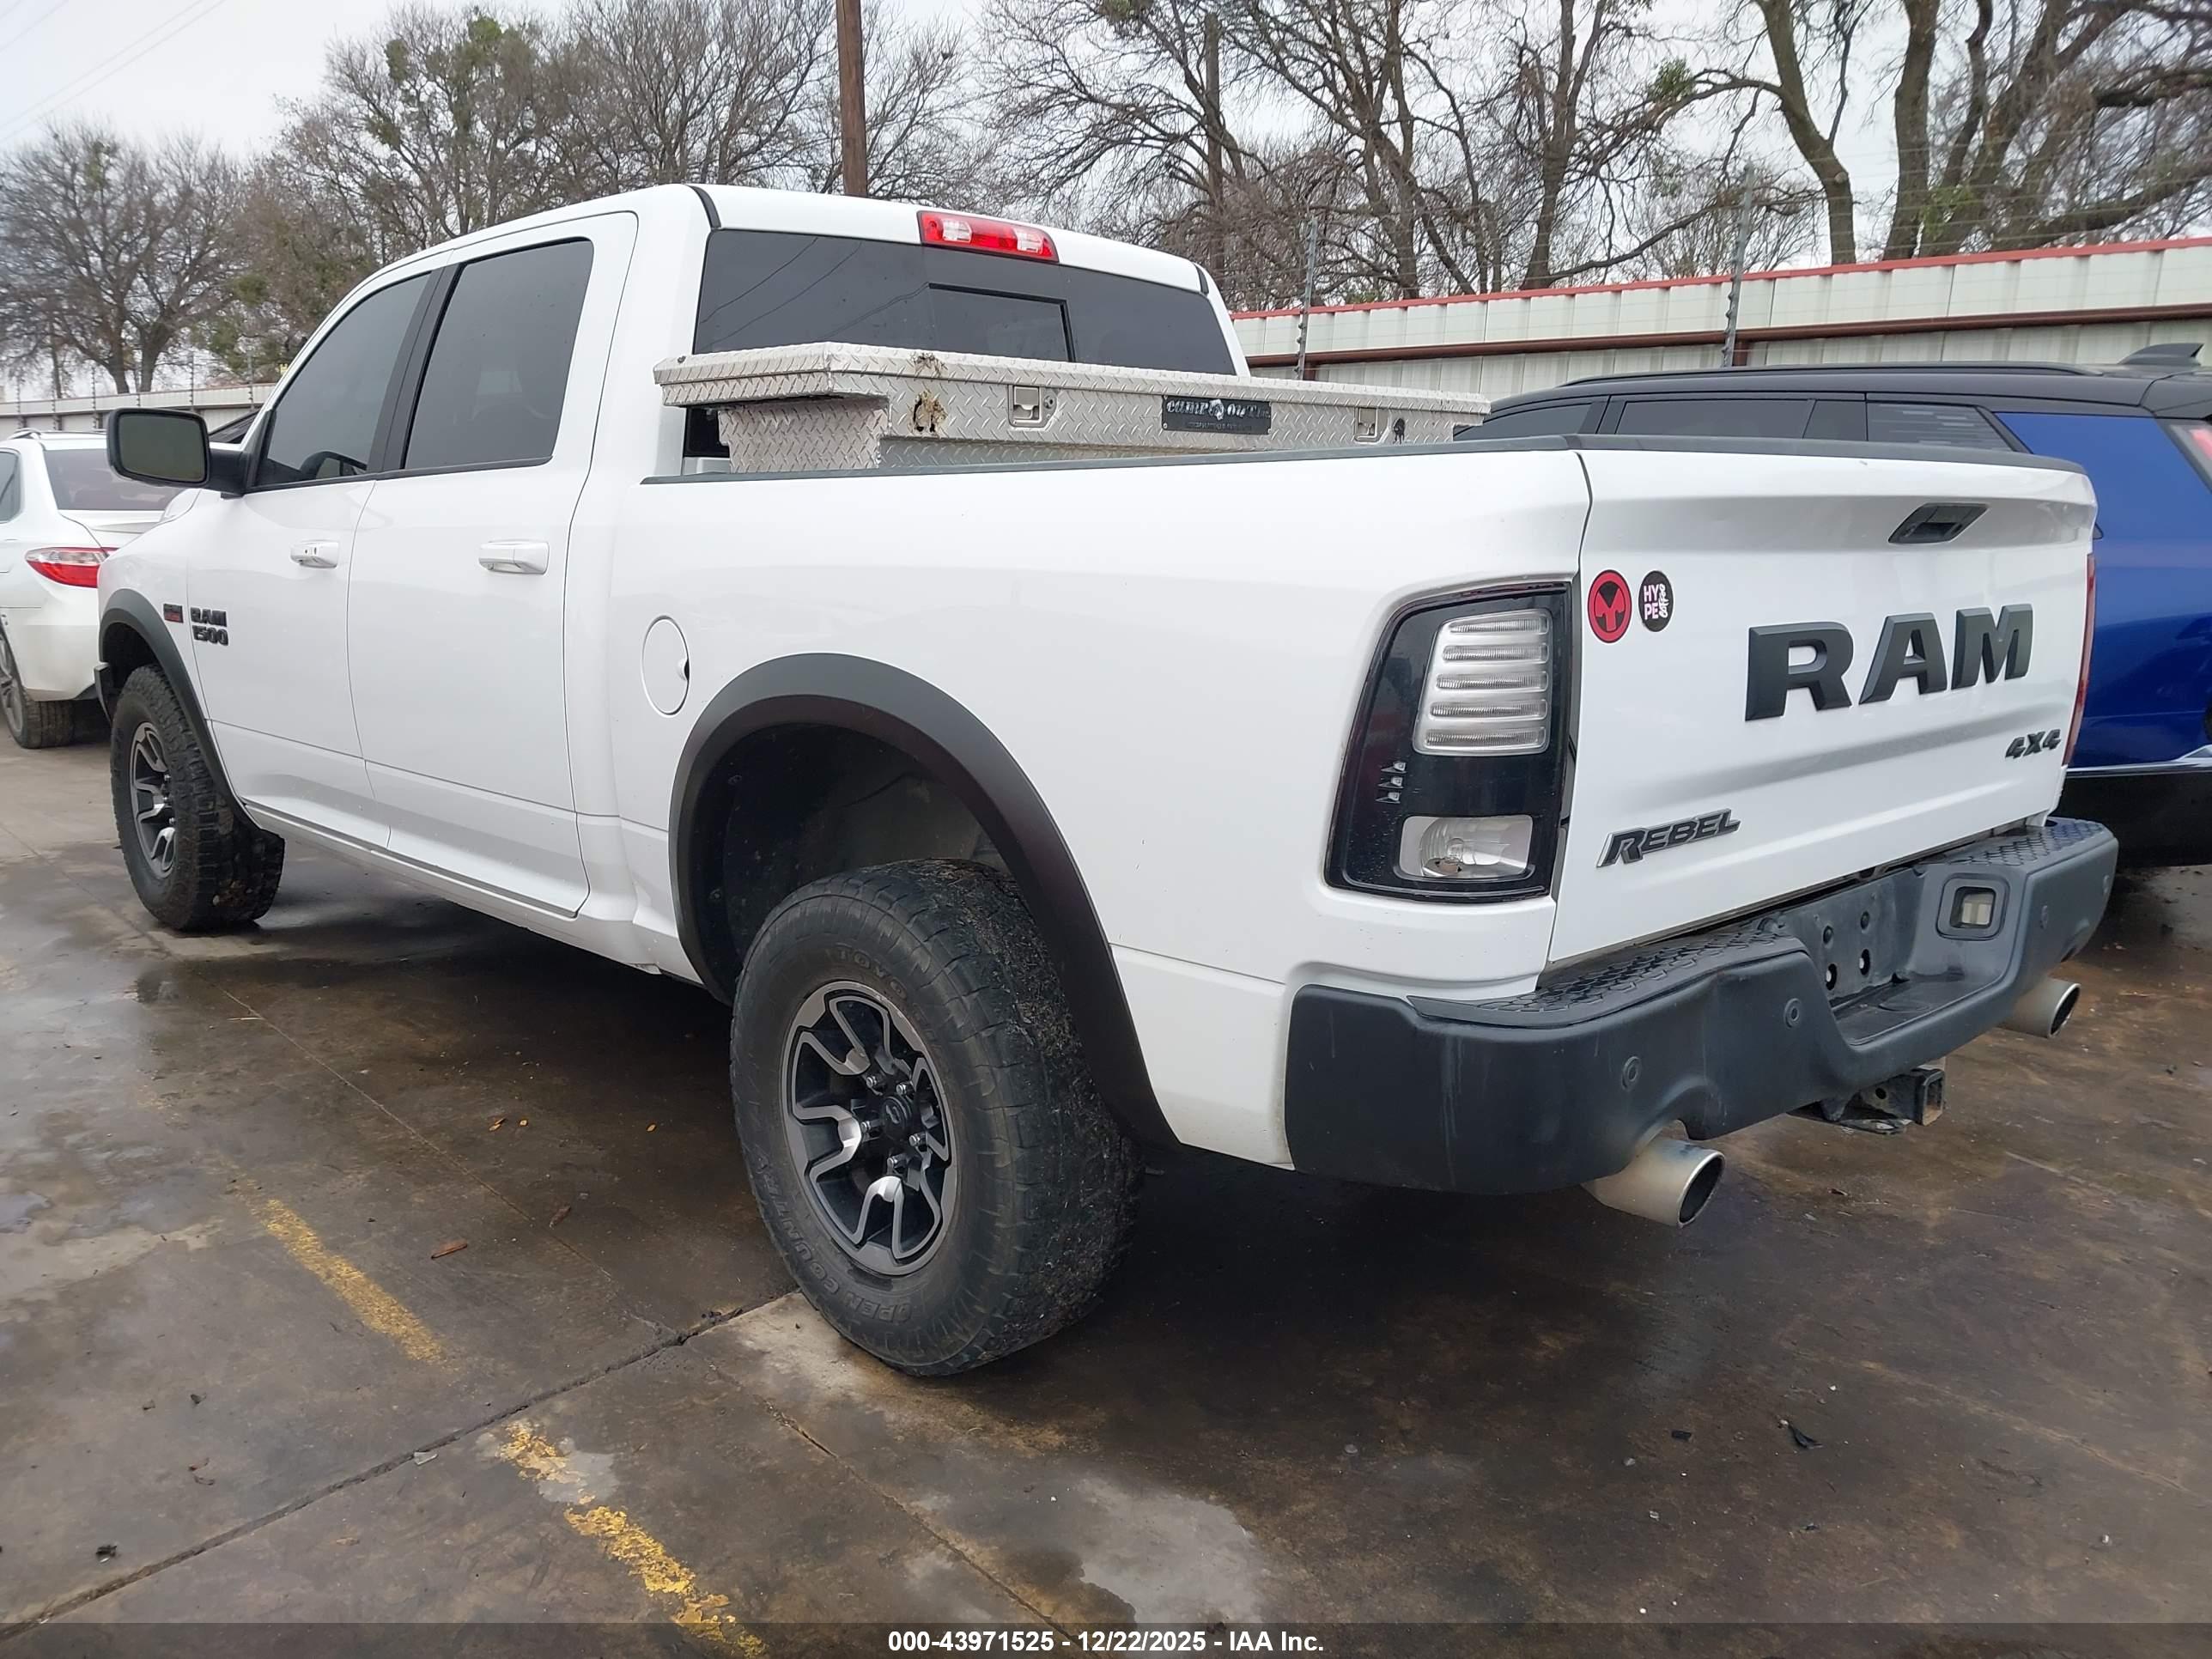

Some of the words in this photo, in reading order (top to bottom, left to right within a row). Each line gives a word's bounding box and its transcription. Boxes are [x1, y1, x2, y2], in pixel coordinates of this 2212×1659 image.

[1644, 584, 1659, 602] HY
[191, 607, 227, 627] RAM
[1644, 603, 1659, 620] PE
[192, 625, 228, 646] 1500
[1745, 603, 2034, 722] RAM
[1595, 807, 1741, 868] REBEL
